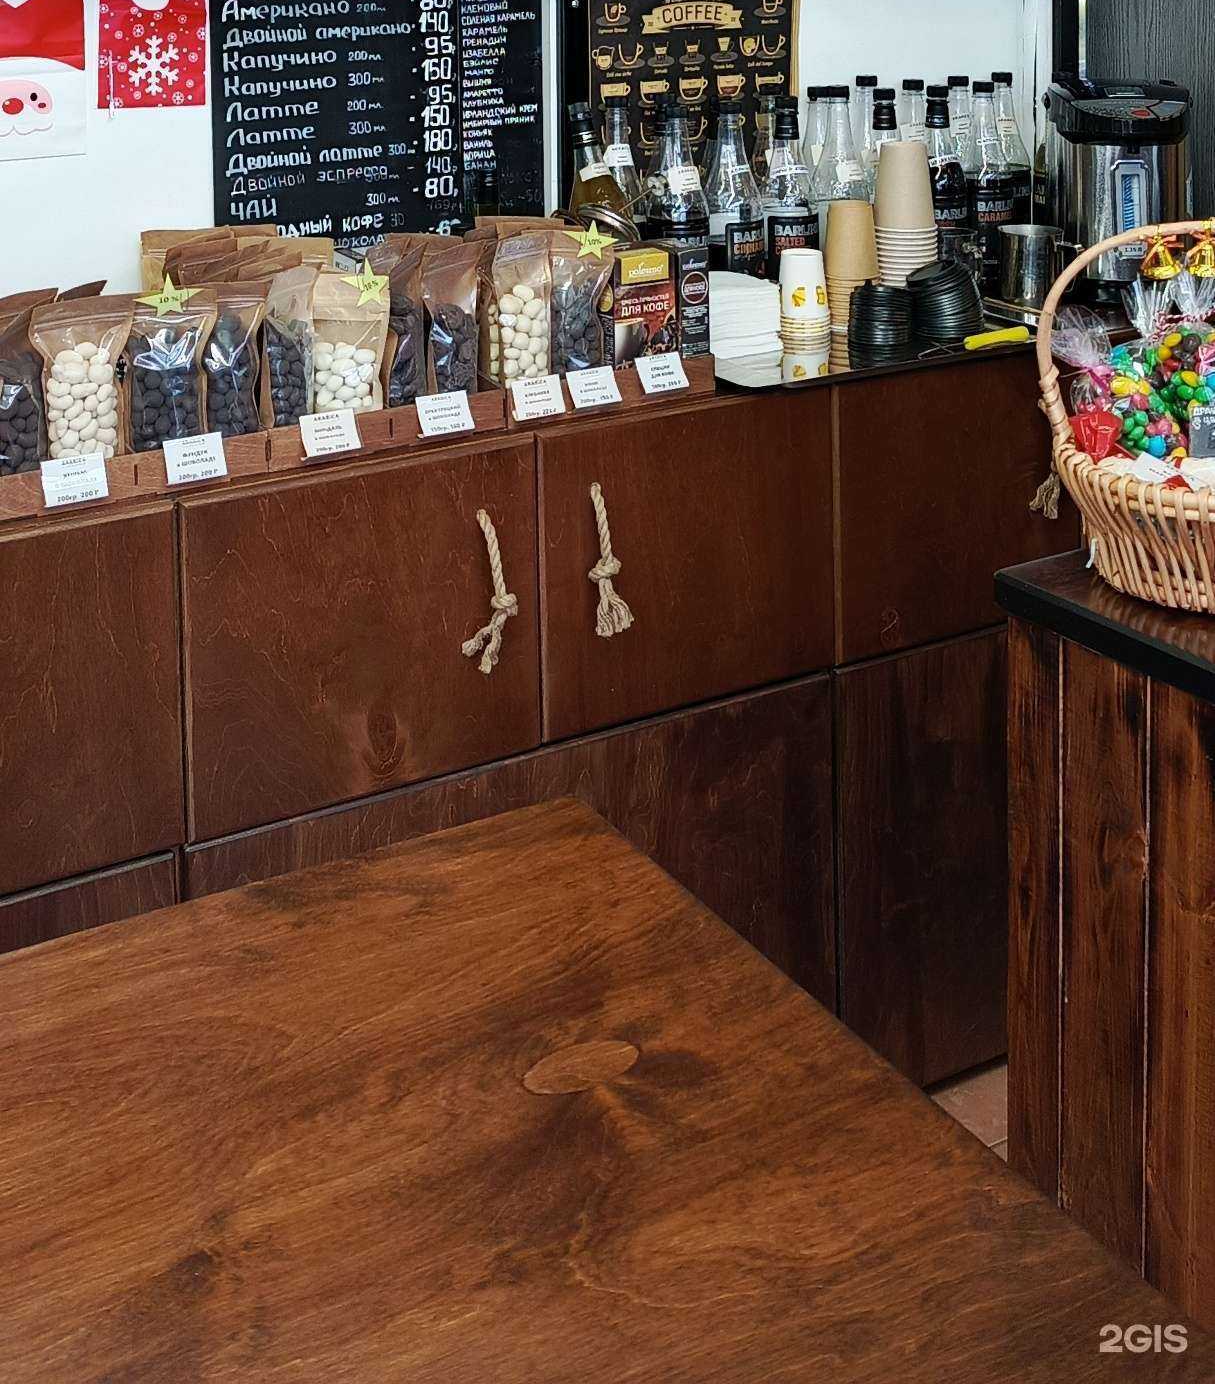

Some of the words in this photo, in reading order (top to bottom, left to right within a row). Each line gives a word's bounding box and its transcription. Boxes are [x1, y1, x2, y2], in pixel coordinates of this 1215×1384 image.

[662, 4, 723, 24] COFFEE
[223, 23, 307, 50] Двойной
[315, 22, 411, 41] американо
[223, 50, 337, 73] Капучино
[224, 75, 337, 97] Капучино
[226, 101, 320, 122] Латте
[226, 126, 317, 147] Латте
[226, 145, 312, 177] Двойной
[319, 144, 382, 162] латте
[231, 194, 277, 220] ЧАЙ
[343, 213, 384, 232] КОФЕ
[775, 237, 805, 246] SALTED
[621, 305, 642, 317] ДЛЯ
[643, 303, 670, 313] КОФЕ
